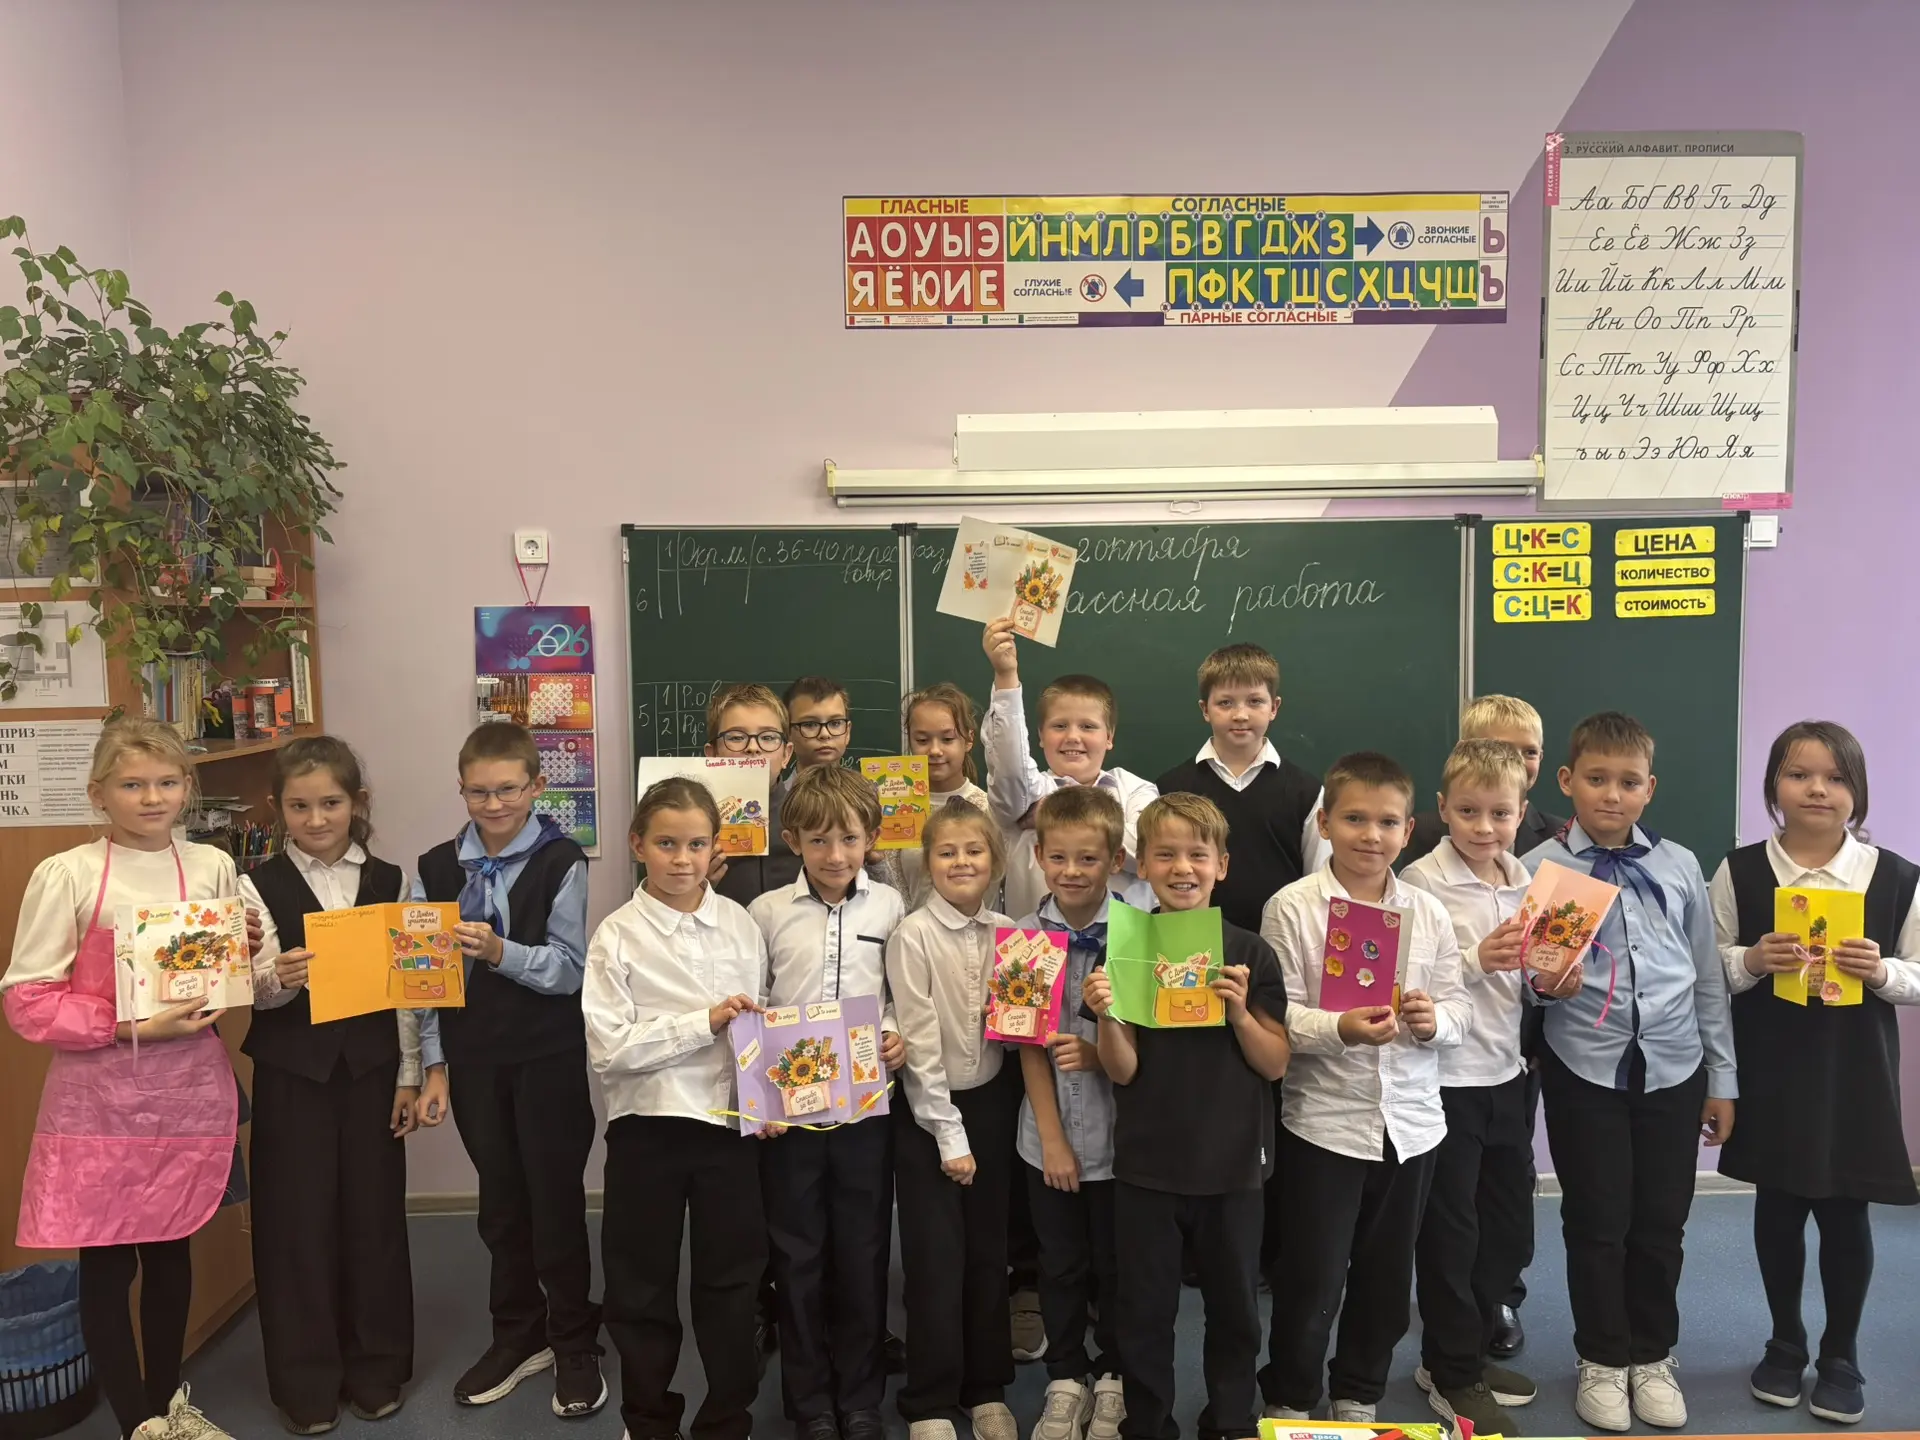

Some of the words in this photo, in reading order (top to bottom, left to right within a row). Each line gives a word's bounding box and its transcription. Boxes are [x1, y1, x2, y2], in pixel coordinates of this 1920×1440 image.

[1576, 143, 1624, 154] РУССКИЙ
[1685, 144, 1734, 153] ПРОПИСИ
[880, 198, 969, 214] ГЛАСНЫЕ
[1171, 197, 1286, 212] СОГЛАСНЫЕ
[1425, 225, 1470, 235] ЗВОНКИЕ
[1483, 217, 1505, 253] Ь
[1418, 235, 1477, 244] СОГЛАСНЫЕ
[1024, 278, 1062, 287] ГЛУХИЕ
[1480, 265, 1504, 301] Ъ
[1013, 287, 1073, 297] СОГЛАСНЫЕ
[1180, 311, 1243, 324] ПАРНЫЕ
[1247, 311, 1338, 323] СОГЛАСНЫЕ
[1634, 533, 1697, 555] ЦЕНА
[1620, 566, 1709, 580] КОЛИЧЕСТВО
[1226, 562, 1385, 638] работа
[1624, 598, 1706, 612] СТОИМОСТЬ
